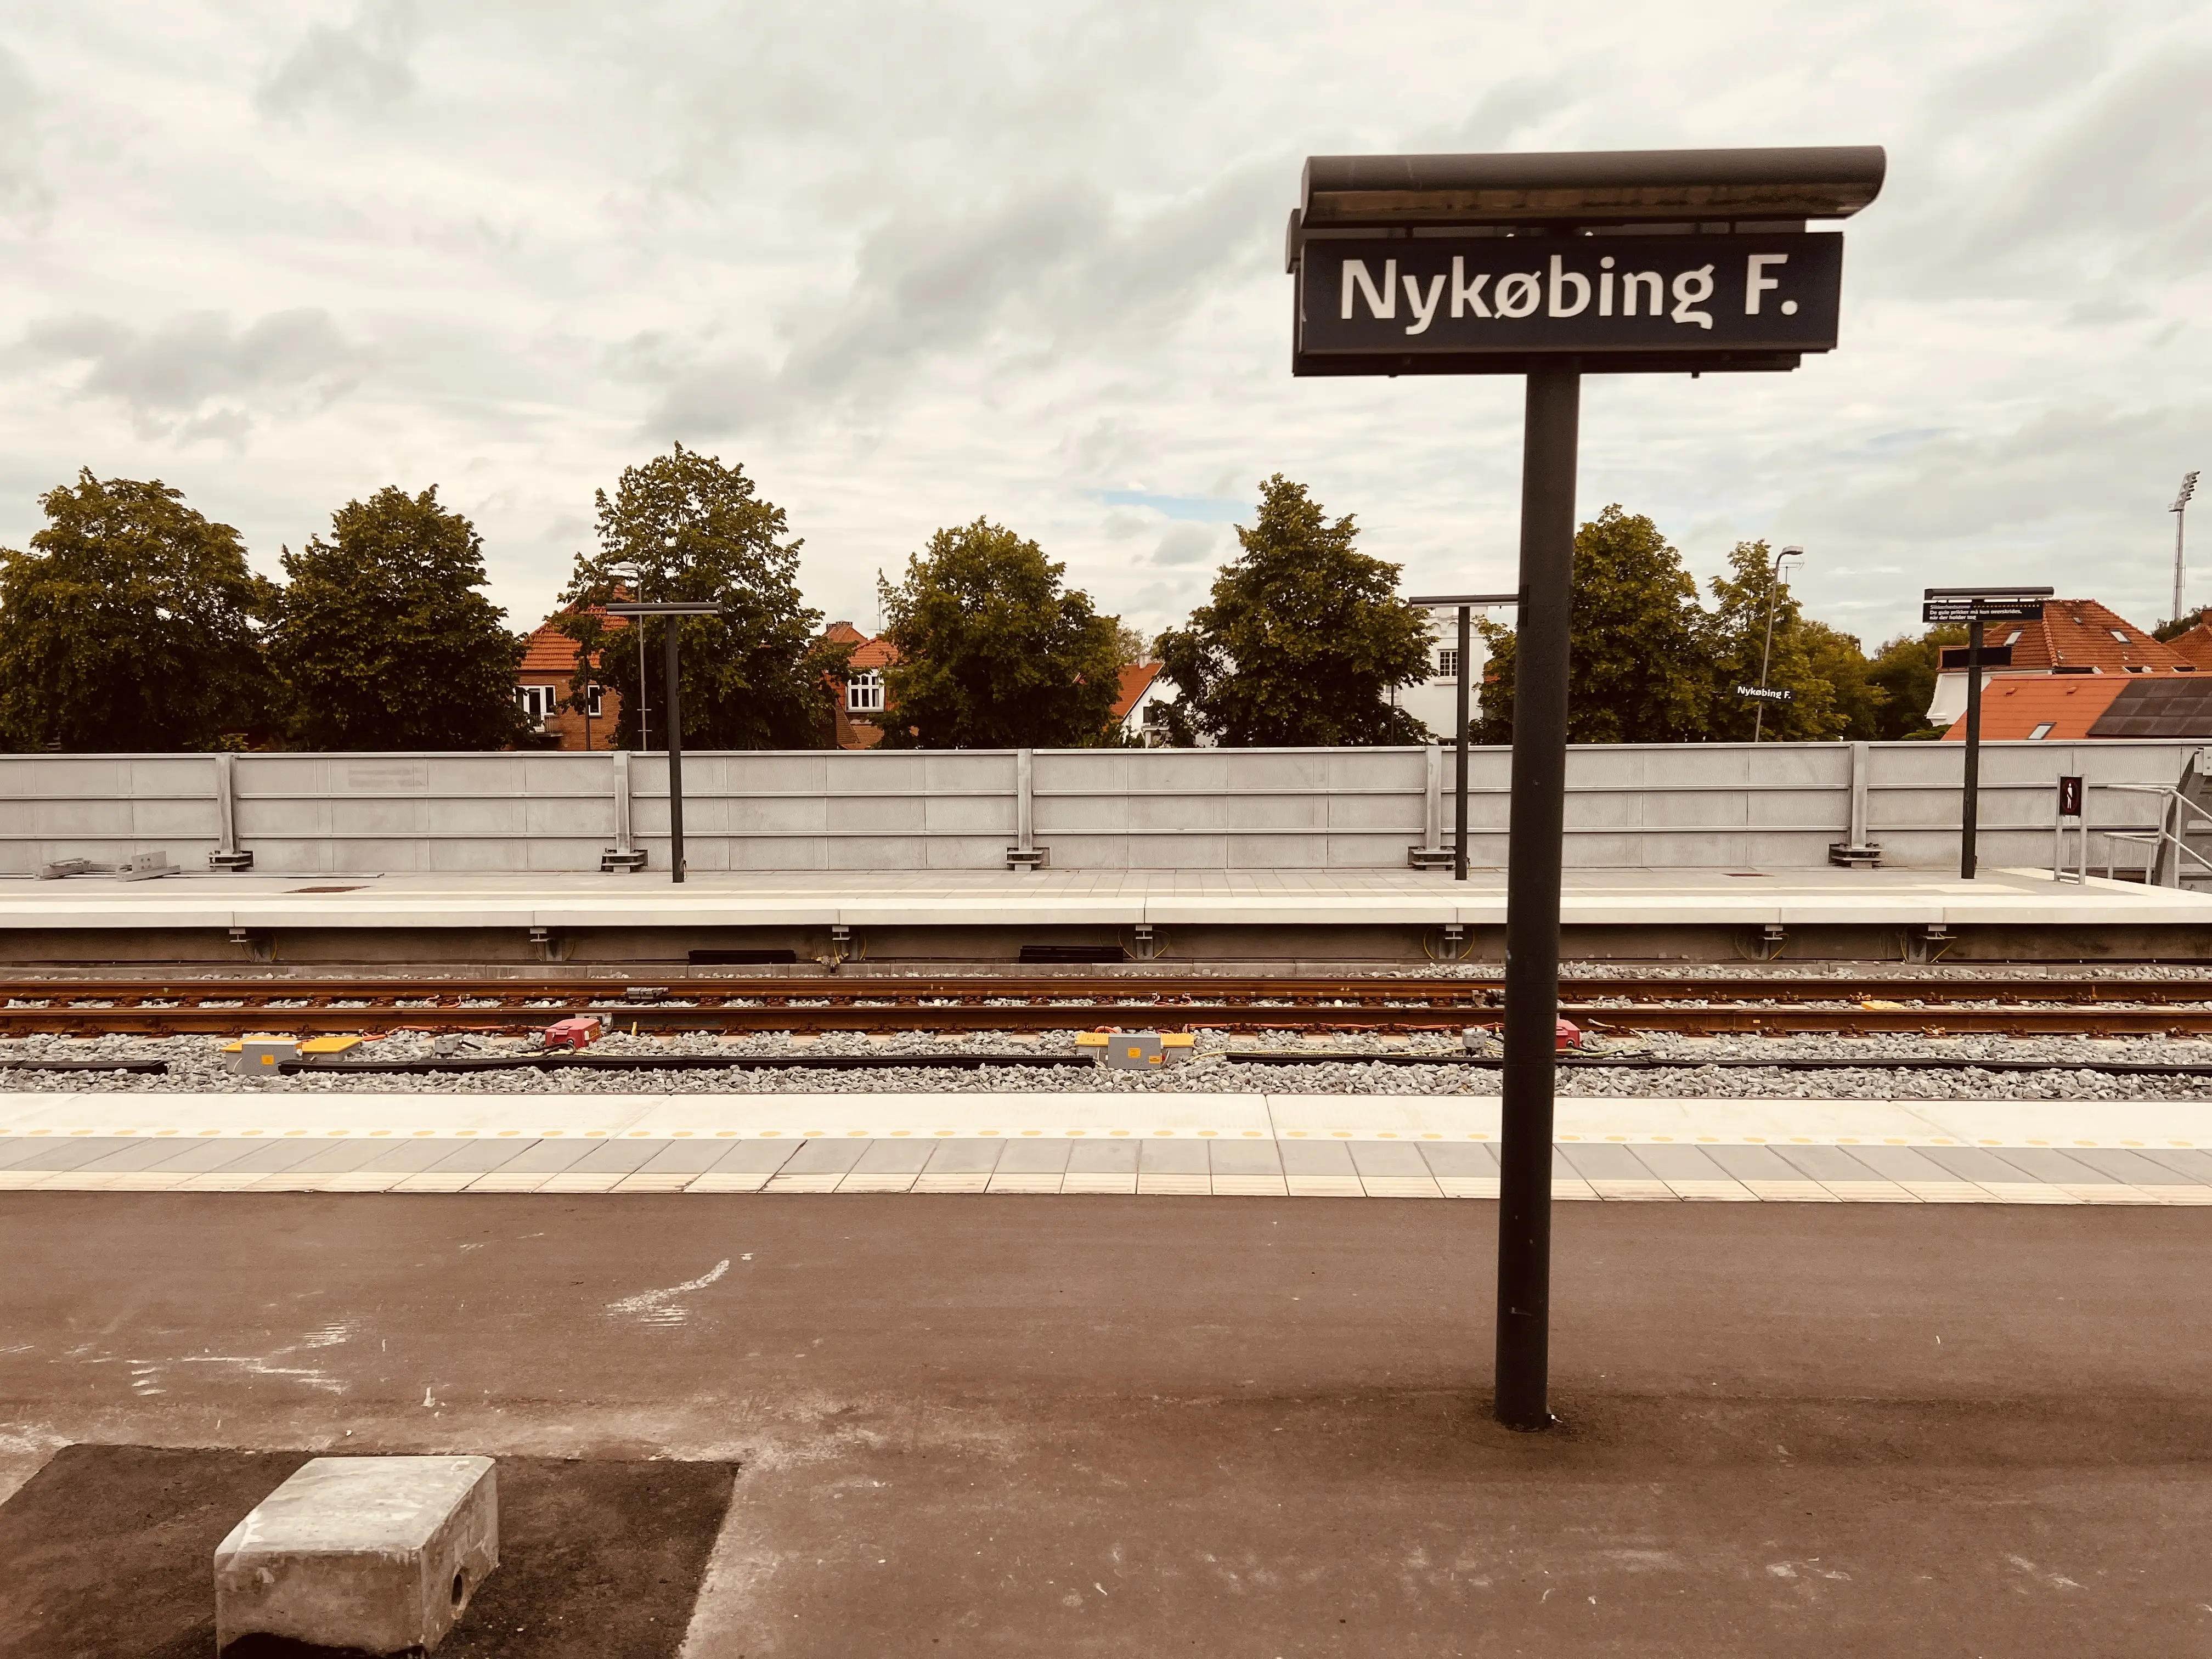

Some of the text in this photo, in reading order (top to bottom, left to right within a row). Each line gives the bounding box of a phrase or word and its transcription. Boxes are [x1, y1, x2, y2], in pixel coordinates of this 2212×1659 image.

[1341, 255, 1798, 335] Nykøbing F.
[1737, 686, 1781, 699] Nykøbing
